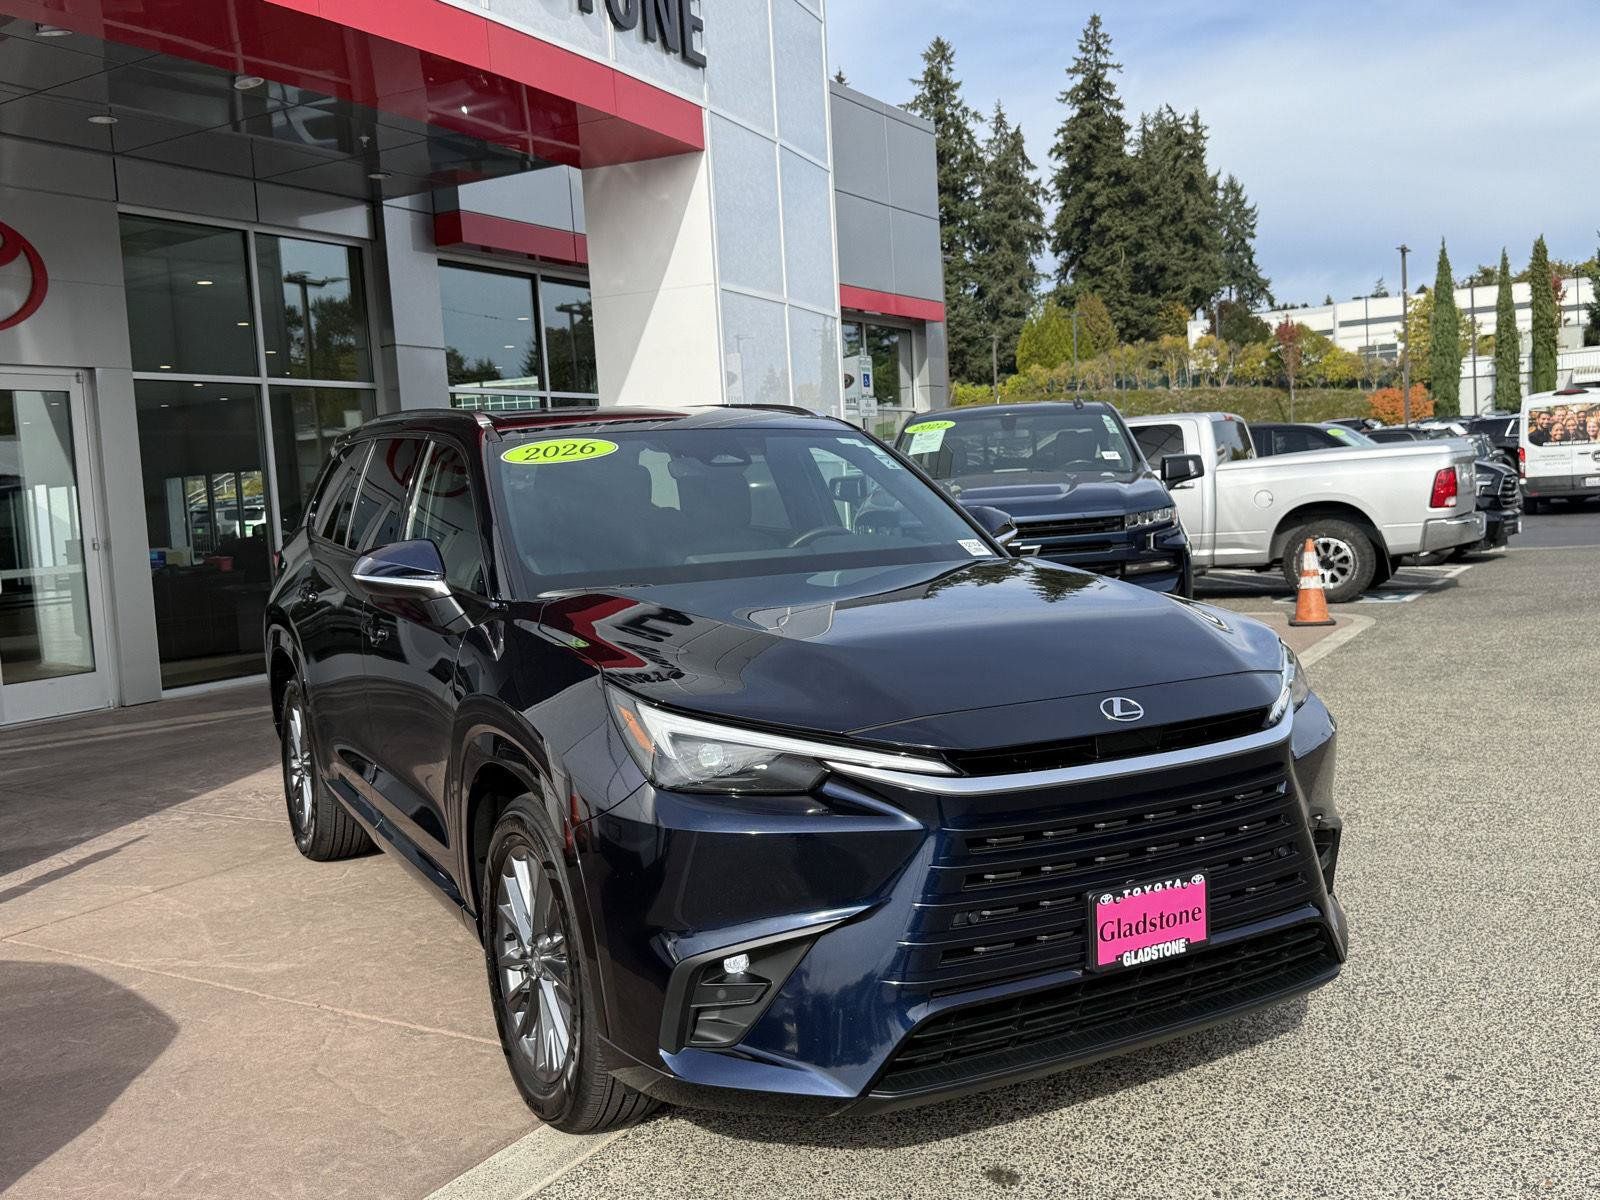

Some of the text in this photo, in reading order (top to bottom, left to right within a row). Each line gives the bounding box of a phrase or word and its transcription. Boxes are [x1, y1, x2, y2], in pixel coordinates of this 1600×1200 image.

[523, 442, 597, 461] 2026
[1122, 878, 1182, 899] TOYOTA
[1099, 906, 1202, 943] Gladstone
[1122, 938, 1187, 967] GLADSTONE
